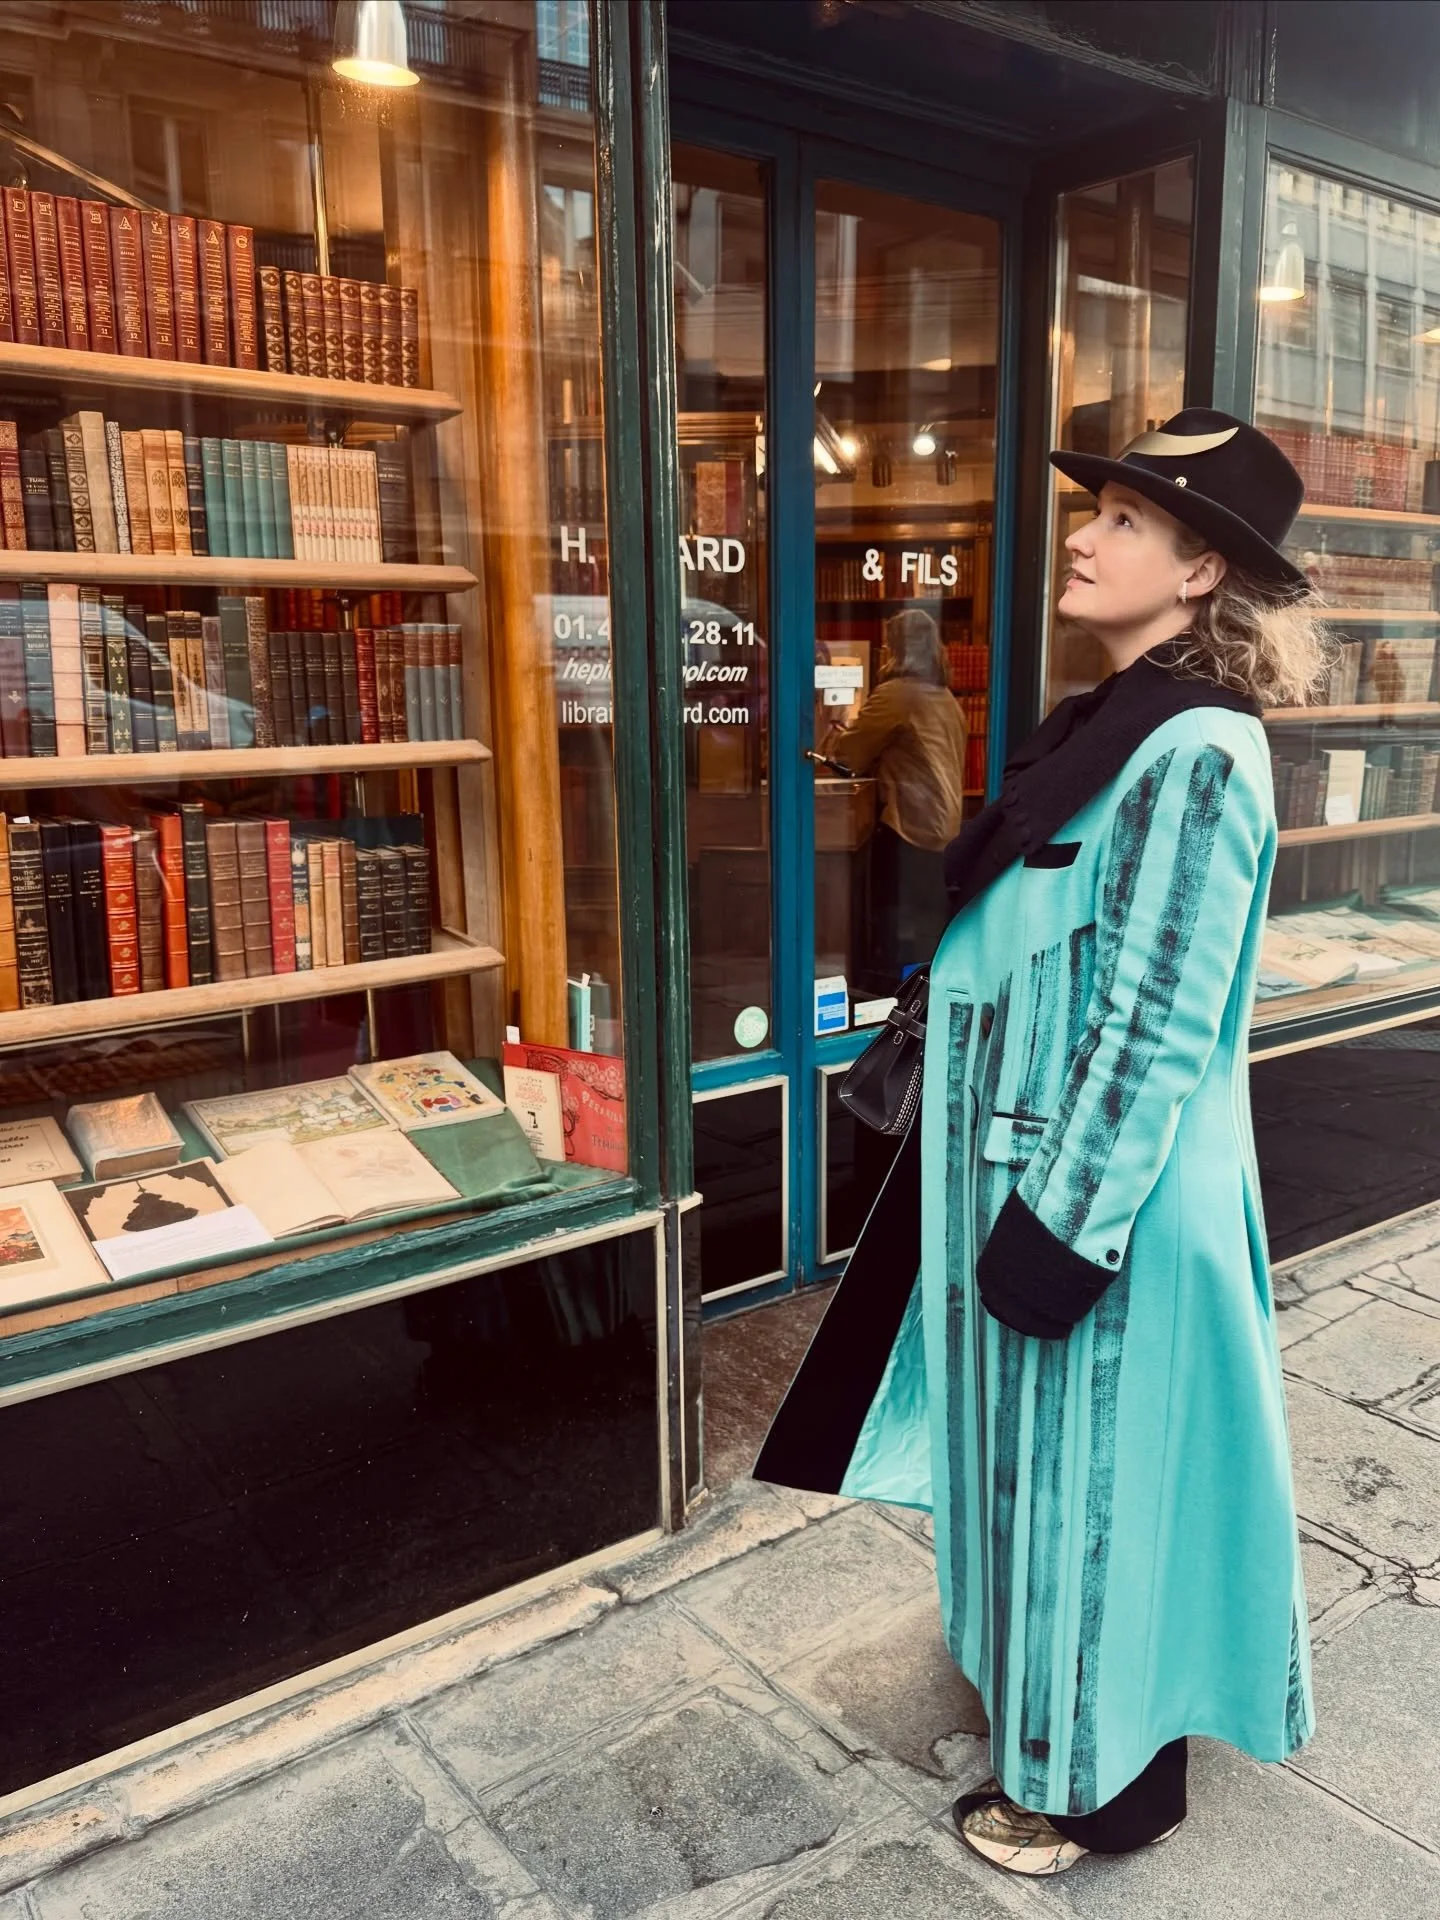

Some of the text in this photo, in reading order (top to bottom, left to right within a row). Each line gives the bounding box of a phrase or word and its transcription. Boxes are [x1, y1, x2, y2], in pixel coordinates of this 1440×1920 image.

[118, 216, 132, 231] A
[151, 221, 163, 235] L
[177, 225, 190, 239] Z
[206, 231, 219, 245] A
[235, 235, 248, 249] C
[560, 525, 596, 564] H.
[862, 548, 884, 581] &
[901, 551, 958, 586] FILS
[683, 661, 748, 682] ol.com
